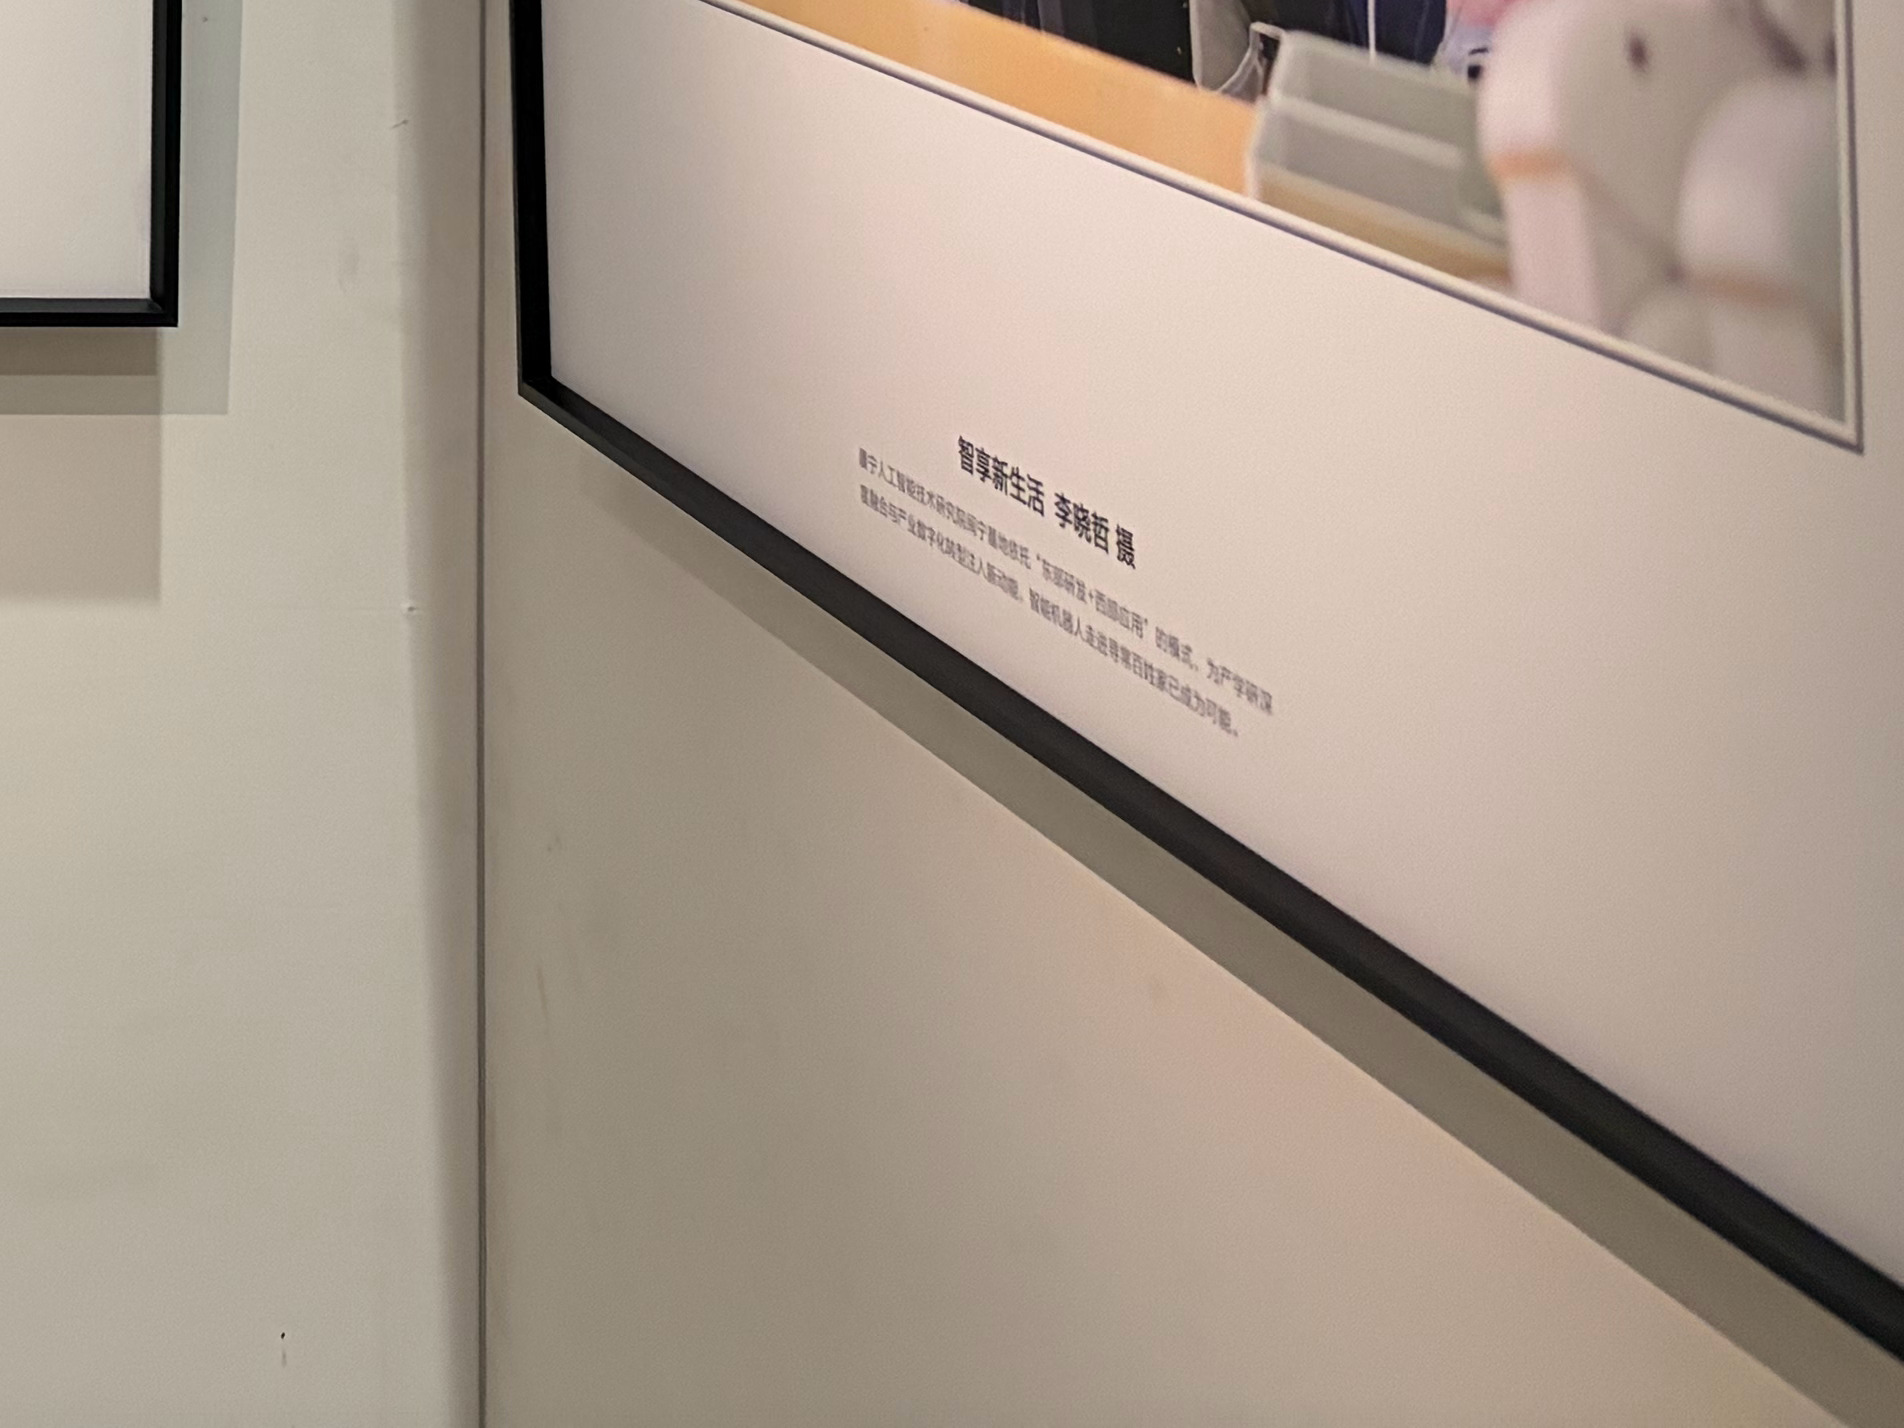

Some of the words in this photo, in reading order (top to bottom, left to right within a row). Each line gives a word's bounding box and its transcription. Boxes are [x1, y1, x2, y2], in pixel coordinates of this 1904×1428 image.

[958, 435, 1045, 517] 智享新生活
[1054, 492, 1111, 555] 李晓哲
[1115, 524, 1137, 569] 摄
